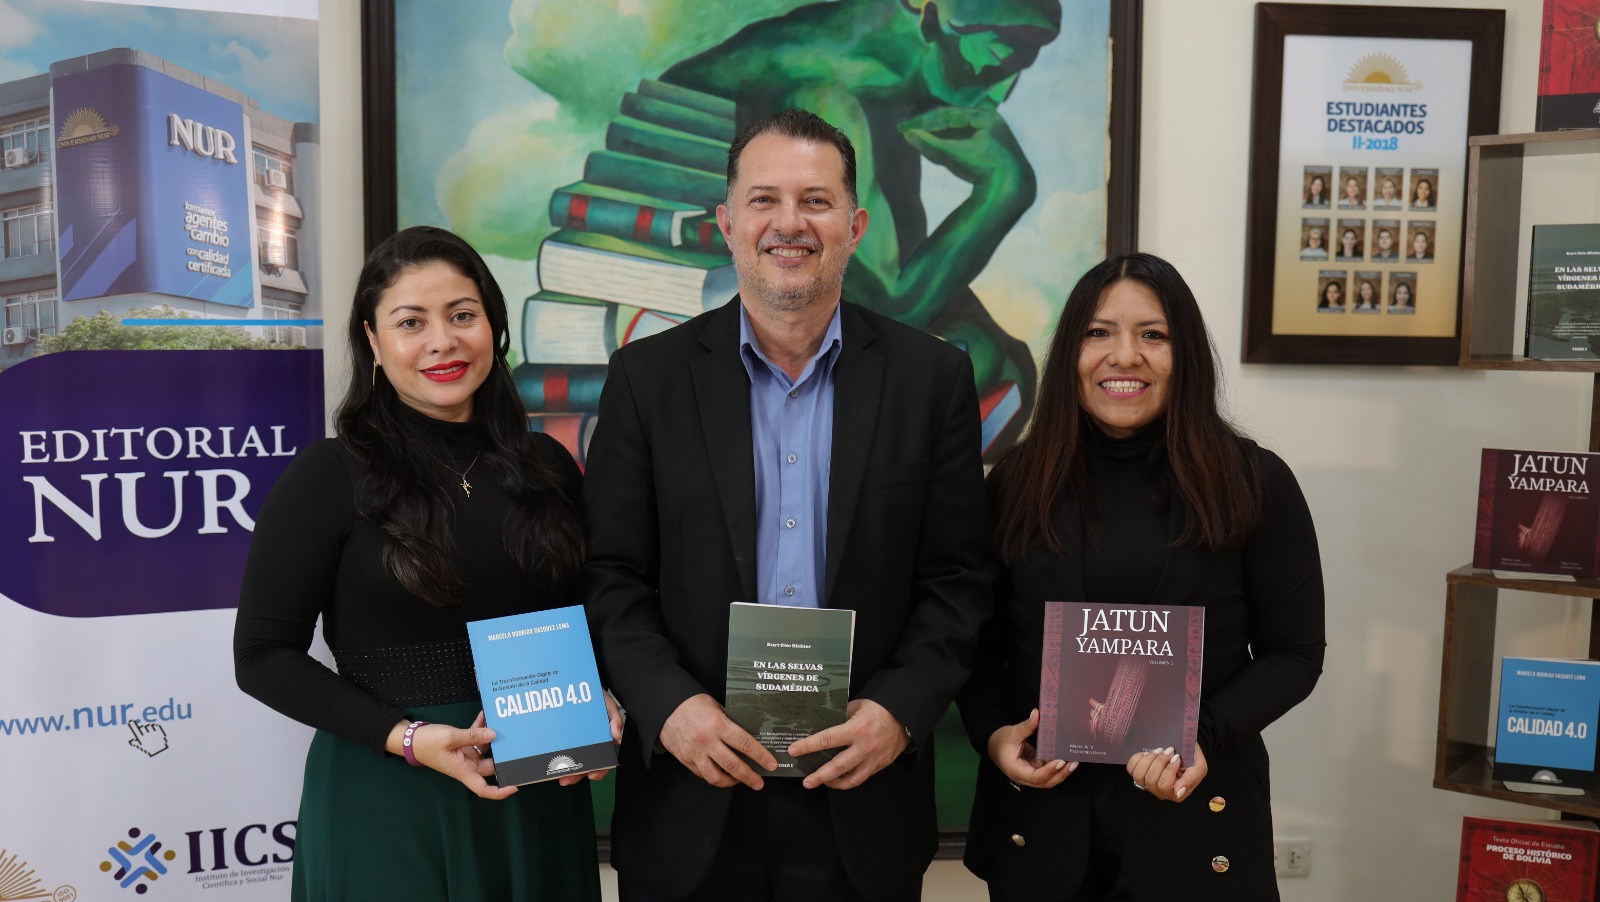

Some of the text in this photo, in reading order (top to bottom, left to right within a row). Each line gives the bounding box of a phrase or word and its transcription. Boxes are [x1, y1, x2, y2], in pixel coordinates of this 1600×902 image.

[1326, 101, 1427, 118] ESTUDIANTES
[1327, 119, 1424, 134] DESTACADOS
[58, 135, 97, 149] UNIVERSIDAD
[168, 113, 239, 164] NUR
[1352, 135, 1398, 150] II-2018
[185, 201, 216, 217] formamos
[185, 211, 228, 232] agentes
[190, 228, 230, 247] cambio
[186, 247, 230, 265] con calidad
[187, 261, 232, 278] certificada
[19, 425, 297, 463] EDITORIAL
[1511, 454, 1588, 476] JATUN
[1508, 476, 1589, 493] YAMPARA
[23, 469, 255, 543] NUR
[1079, 608, 1170, 636] JATUN
[1075, 637, 1174, 657] YAMPARA
[753, 661, 823, 671] EN LAS SELVAS
[757, 671, 804, 681] VÍRGENES
[756, 683, 819, 693] SUDAMÉRICA
[495, 681, 592, 718] CALIDAD 4.0
[1507, 716, 1587, 739] CALIDAD 4.0
[185, 821, 298, 874] IICS
[1486, 844, 1572, 860] PROCESO HISTÓRICO
[1541, 841, 1565, 850] Estudio
[1516, 854, 1551, 864] BOLIVIA
[195, 866, 290, 882] Instituto de Investigación
[202, 880, 237, 889] Científica
[246, 875, 268, 884] Social
[270, 873, 284, 881] Nur
[56, 888, 70, 897] ISO
[59, 893, 74, 902] 9001
